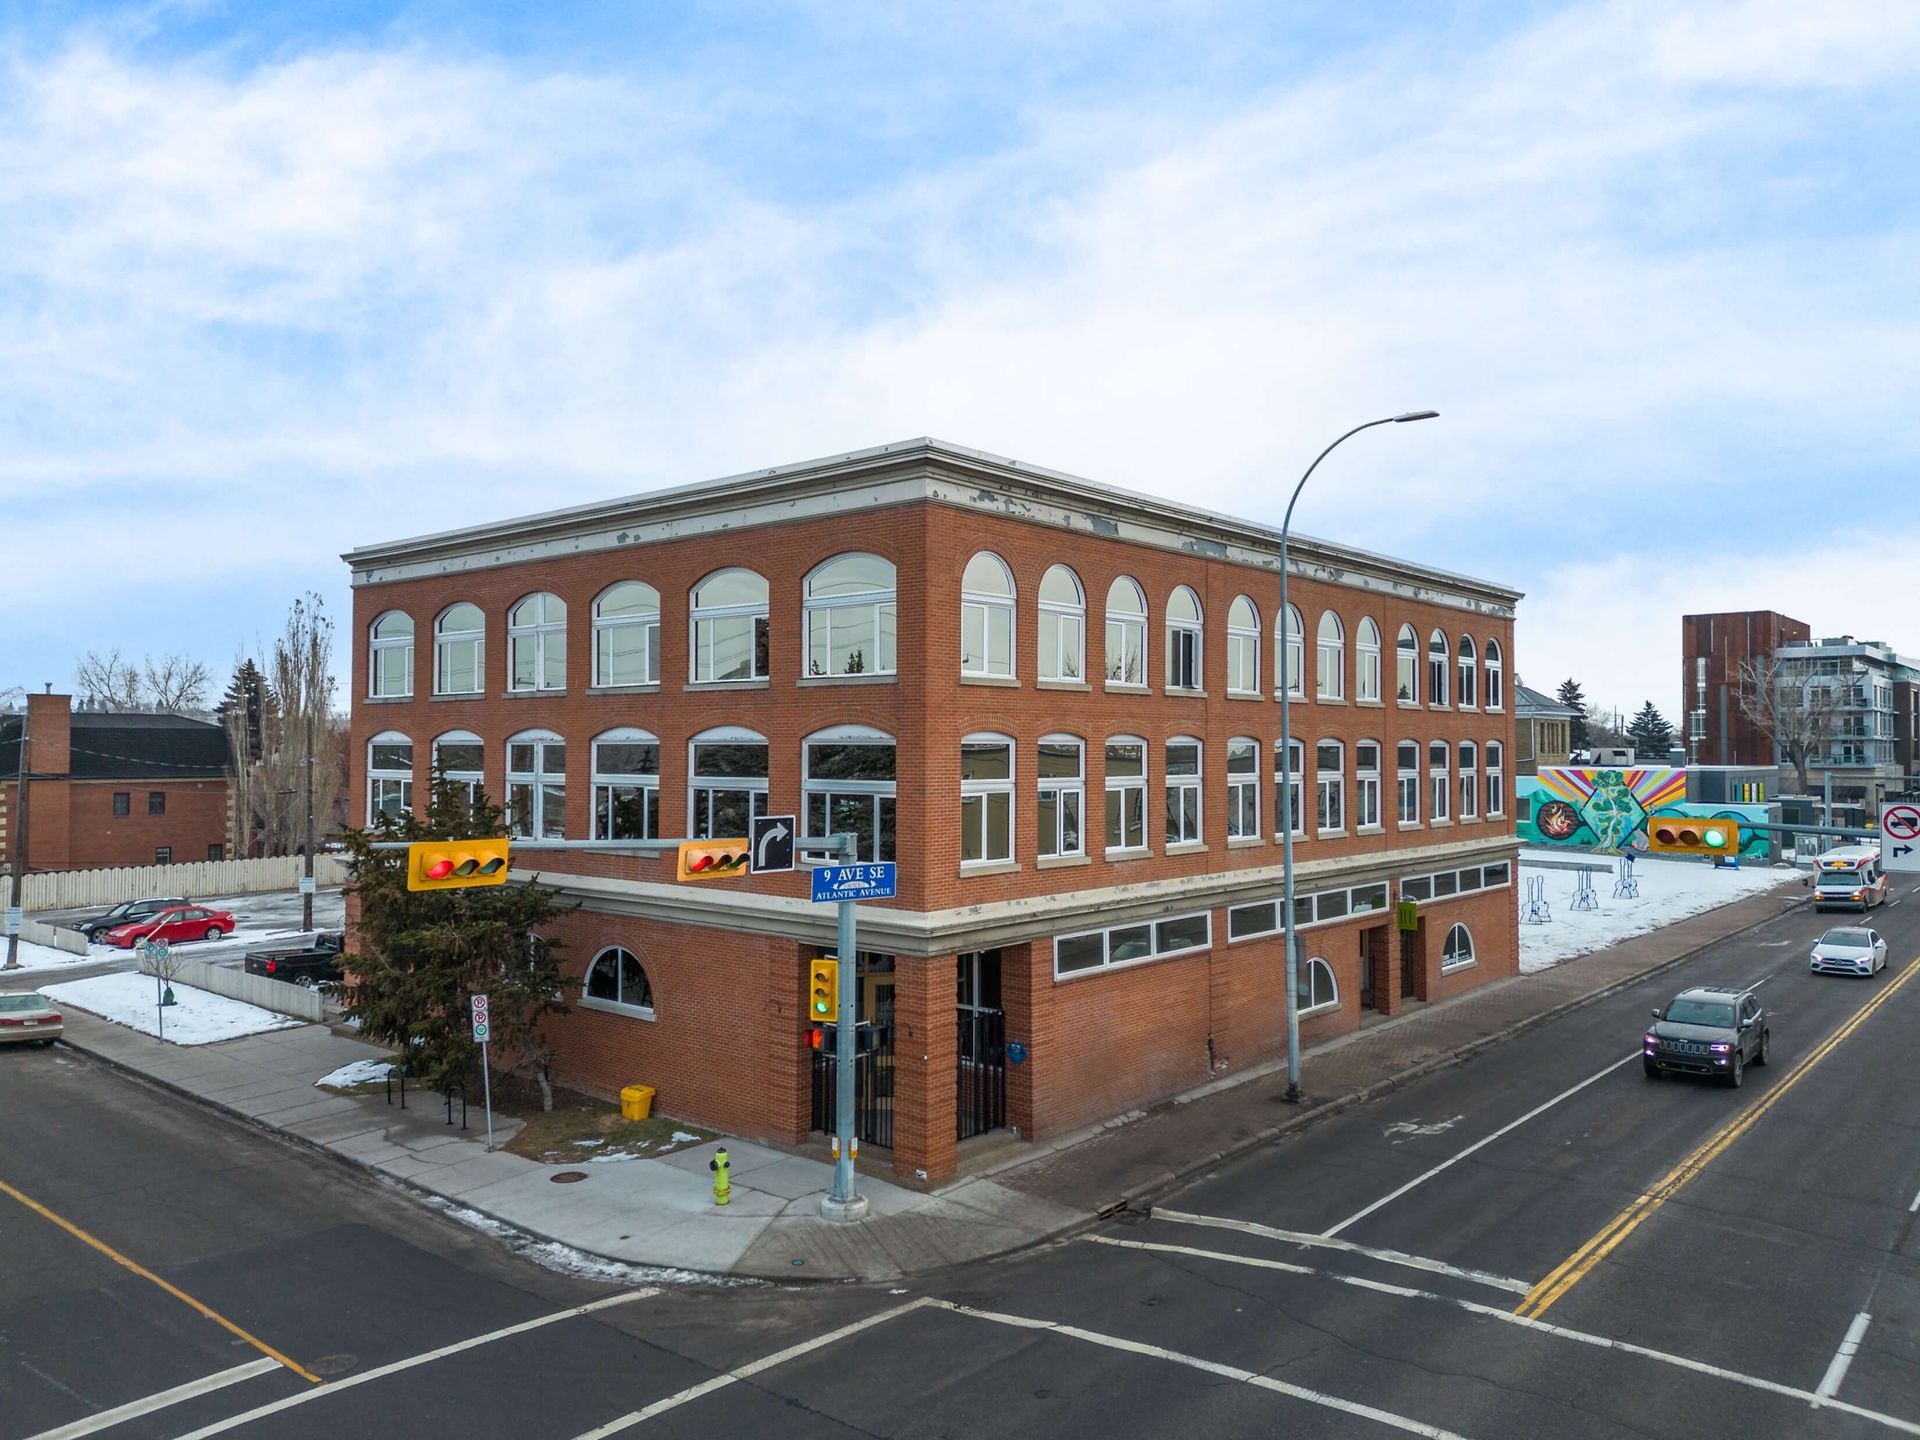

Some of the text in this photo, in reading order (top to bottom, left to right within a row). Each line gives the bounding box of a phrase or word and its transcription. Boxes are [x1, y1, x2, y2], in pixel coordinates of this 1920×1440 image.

[824, 866, 885, 882] 9 AVE SE
[816, 888, 891, 900] ATLANTIC AVENUE
